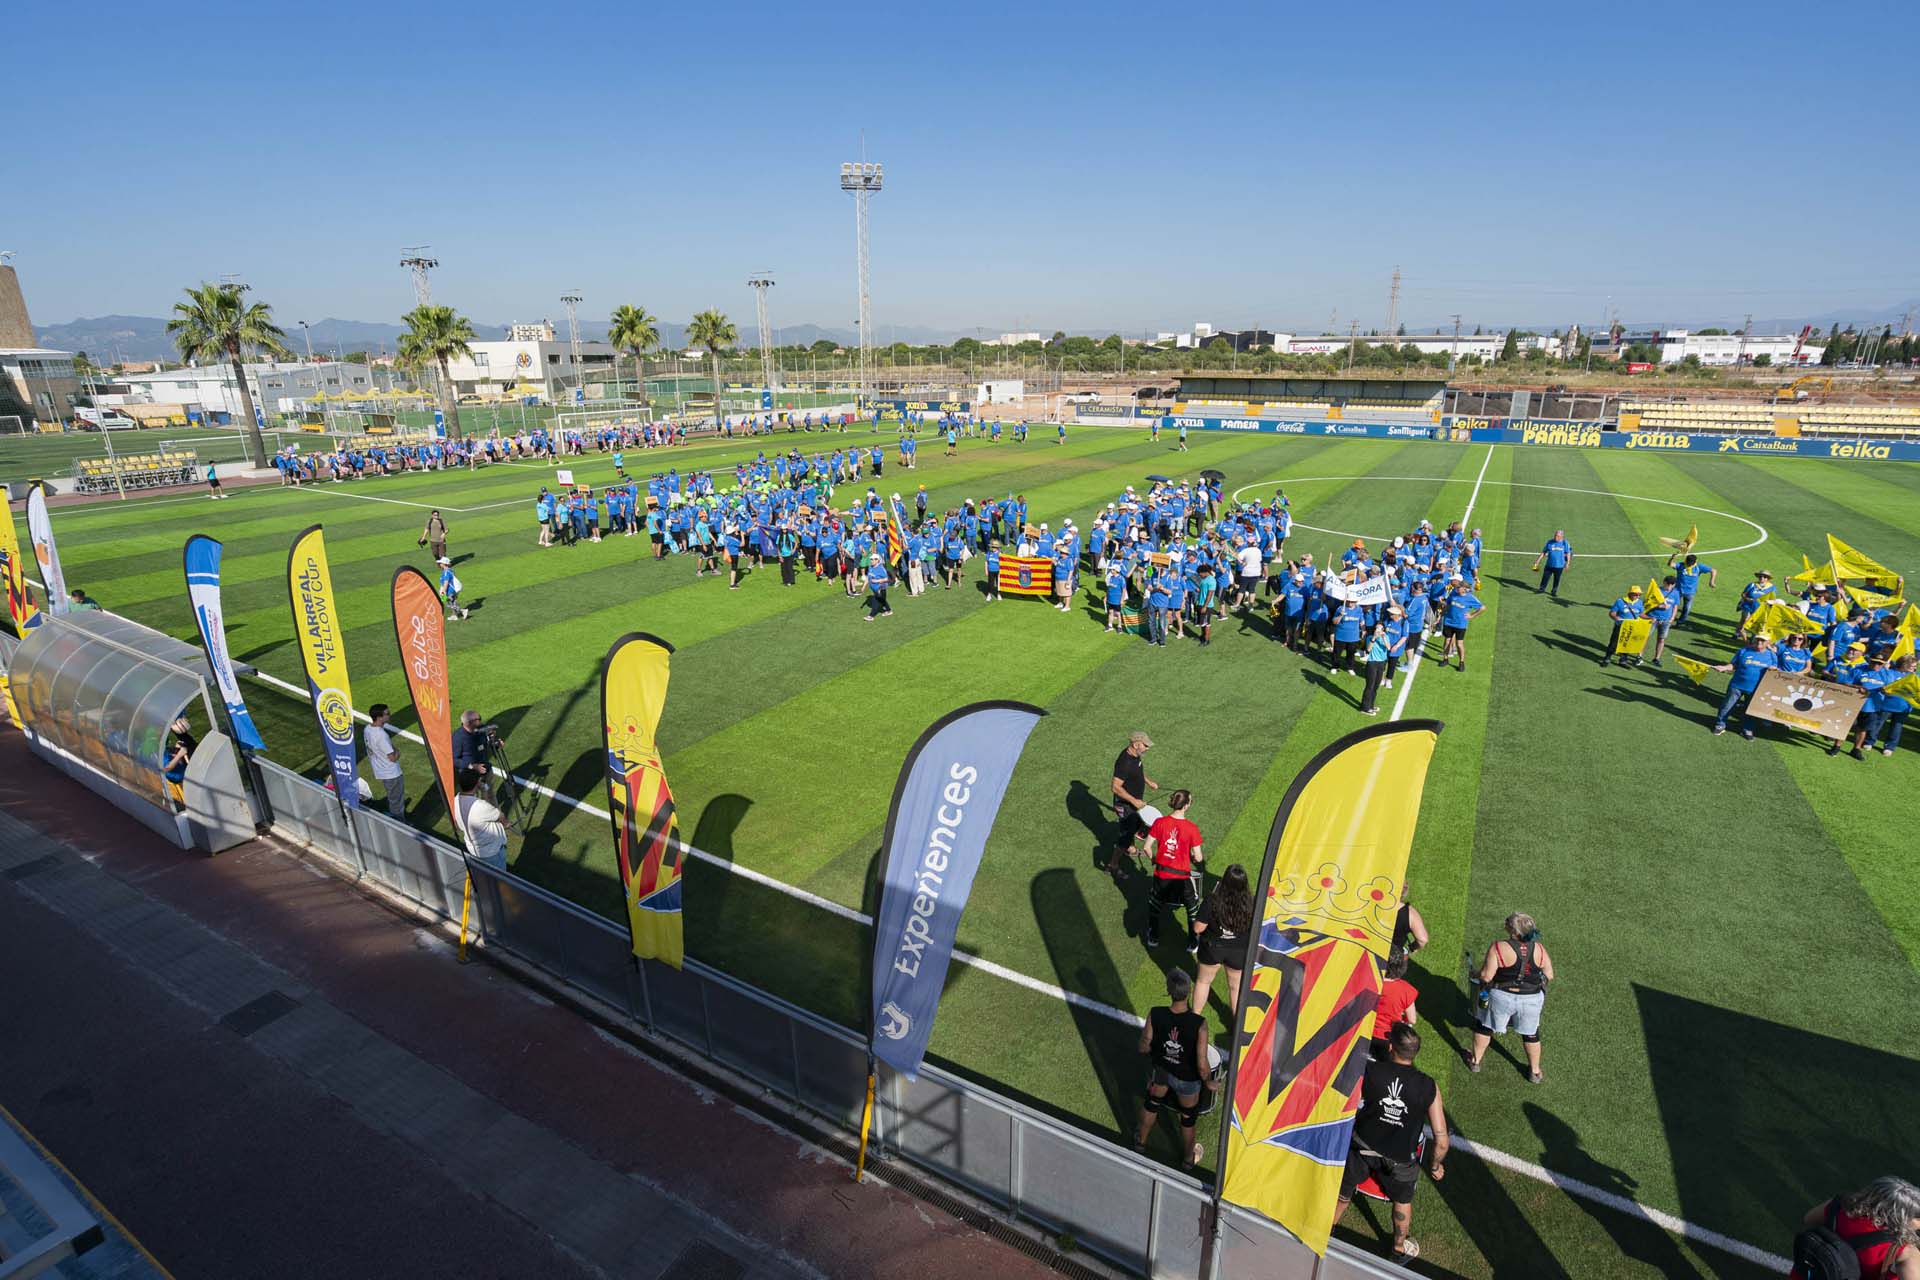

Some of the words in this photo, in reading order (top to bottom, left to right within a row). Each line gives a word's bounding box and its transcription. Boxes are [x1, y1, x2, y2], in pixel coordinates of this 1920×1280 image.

[1221, 419, 1260, 430] PAMESA
[1276, 421, 1307, 433] Coca-Cola
[1338, 424, 1368, 434] CaixaBank
[1451, 418, 1489, 430] teika
[1512, 420, 1602, 432] villarrealcf.es
[1522, 429, 1602, 447] PAMESA
[1743, 439, 1799, 451] CaixaBank
[1830, 440, 1892, 459] teika
[307, 557, 324, 592] CUP
[298, 569, 328, 674] VILLARREAL
[313, 596, 337, 662] YELLOW
[894, 761, 978, 979] Experiences
